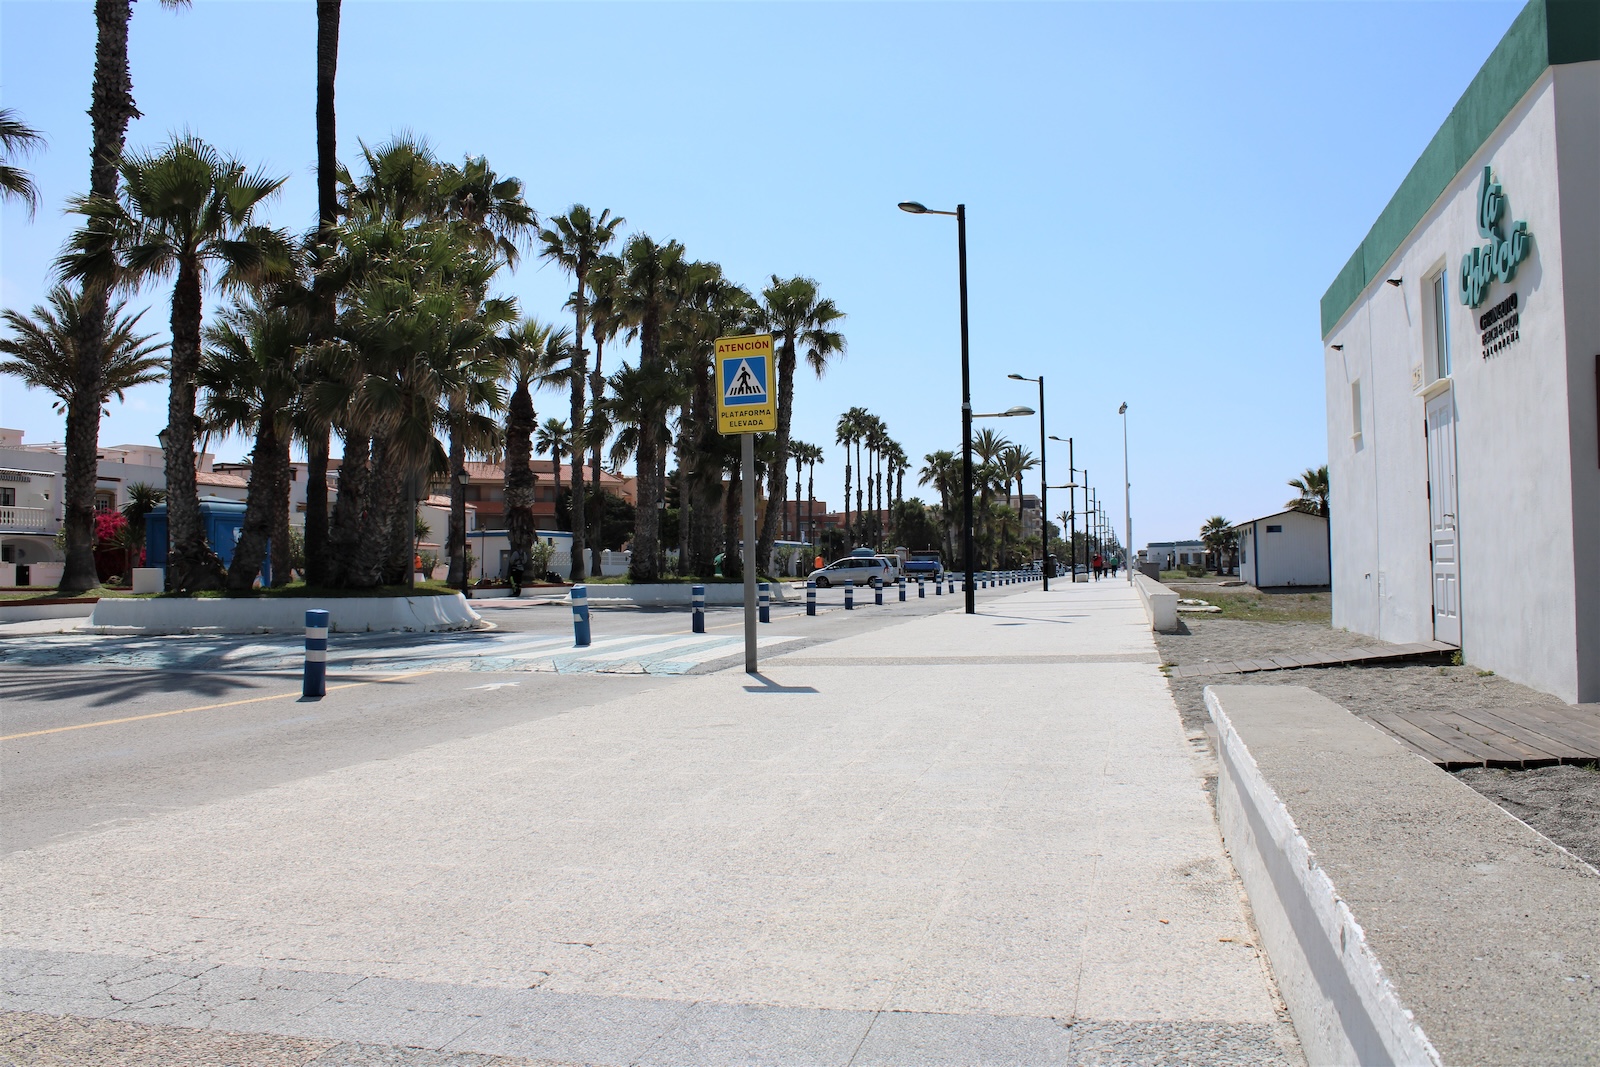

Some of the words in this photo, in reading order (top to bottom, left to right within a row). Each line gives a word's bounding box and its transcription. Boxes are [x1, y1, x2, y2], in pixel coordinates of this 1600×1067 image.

[718, 339, 769, 353] ATENCIÓN
[721, 409, 771, 419] PLATAFORMA
[729, 419, 764, 428] ELEVADA
